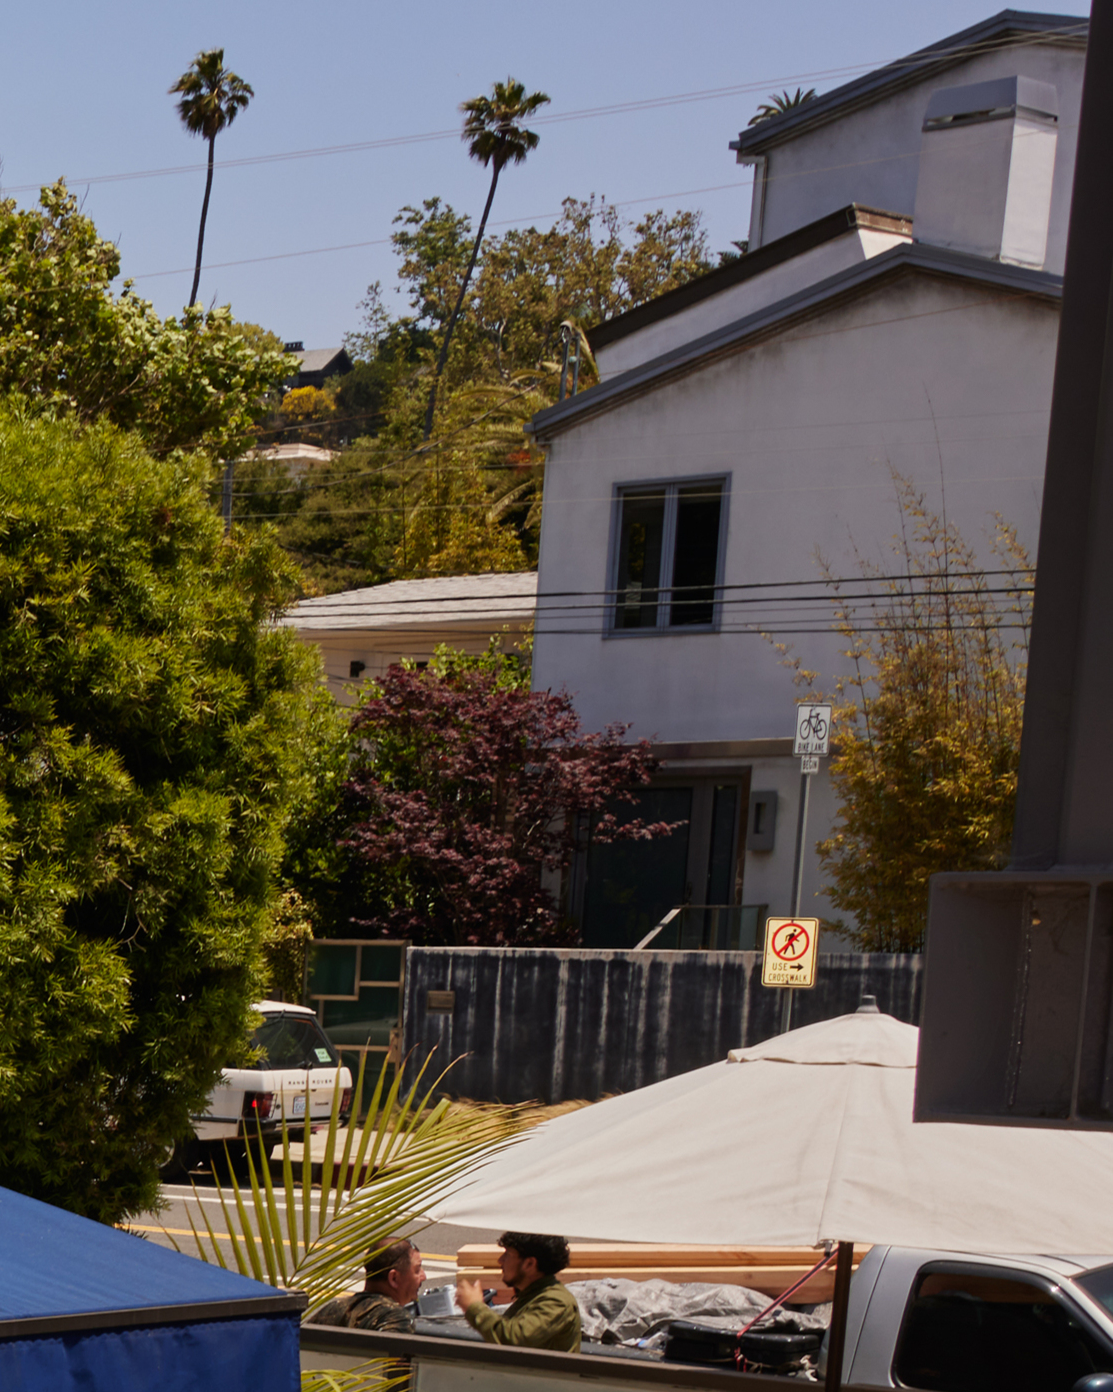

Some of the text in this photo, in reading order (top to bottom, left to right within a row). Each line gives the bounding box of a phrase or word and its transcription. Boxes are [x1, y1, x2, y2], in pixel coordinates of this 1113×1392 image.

[798, 742, 825, 754] BIKE LANE
[803, 760, 818, 771] BEGIN
[772, 962, 788, 972] USE
[768, 973, 808, 984] CROSSWALK
